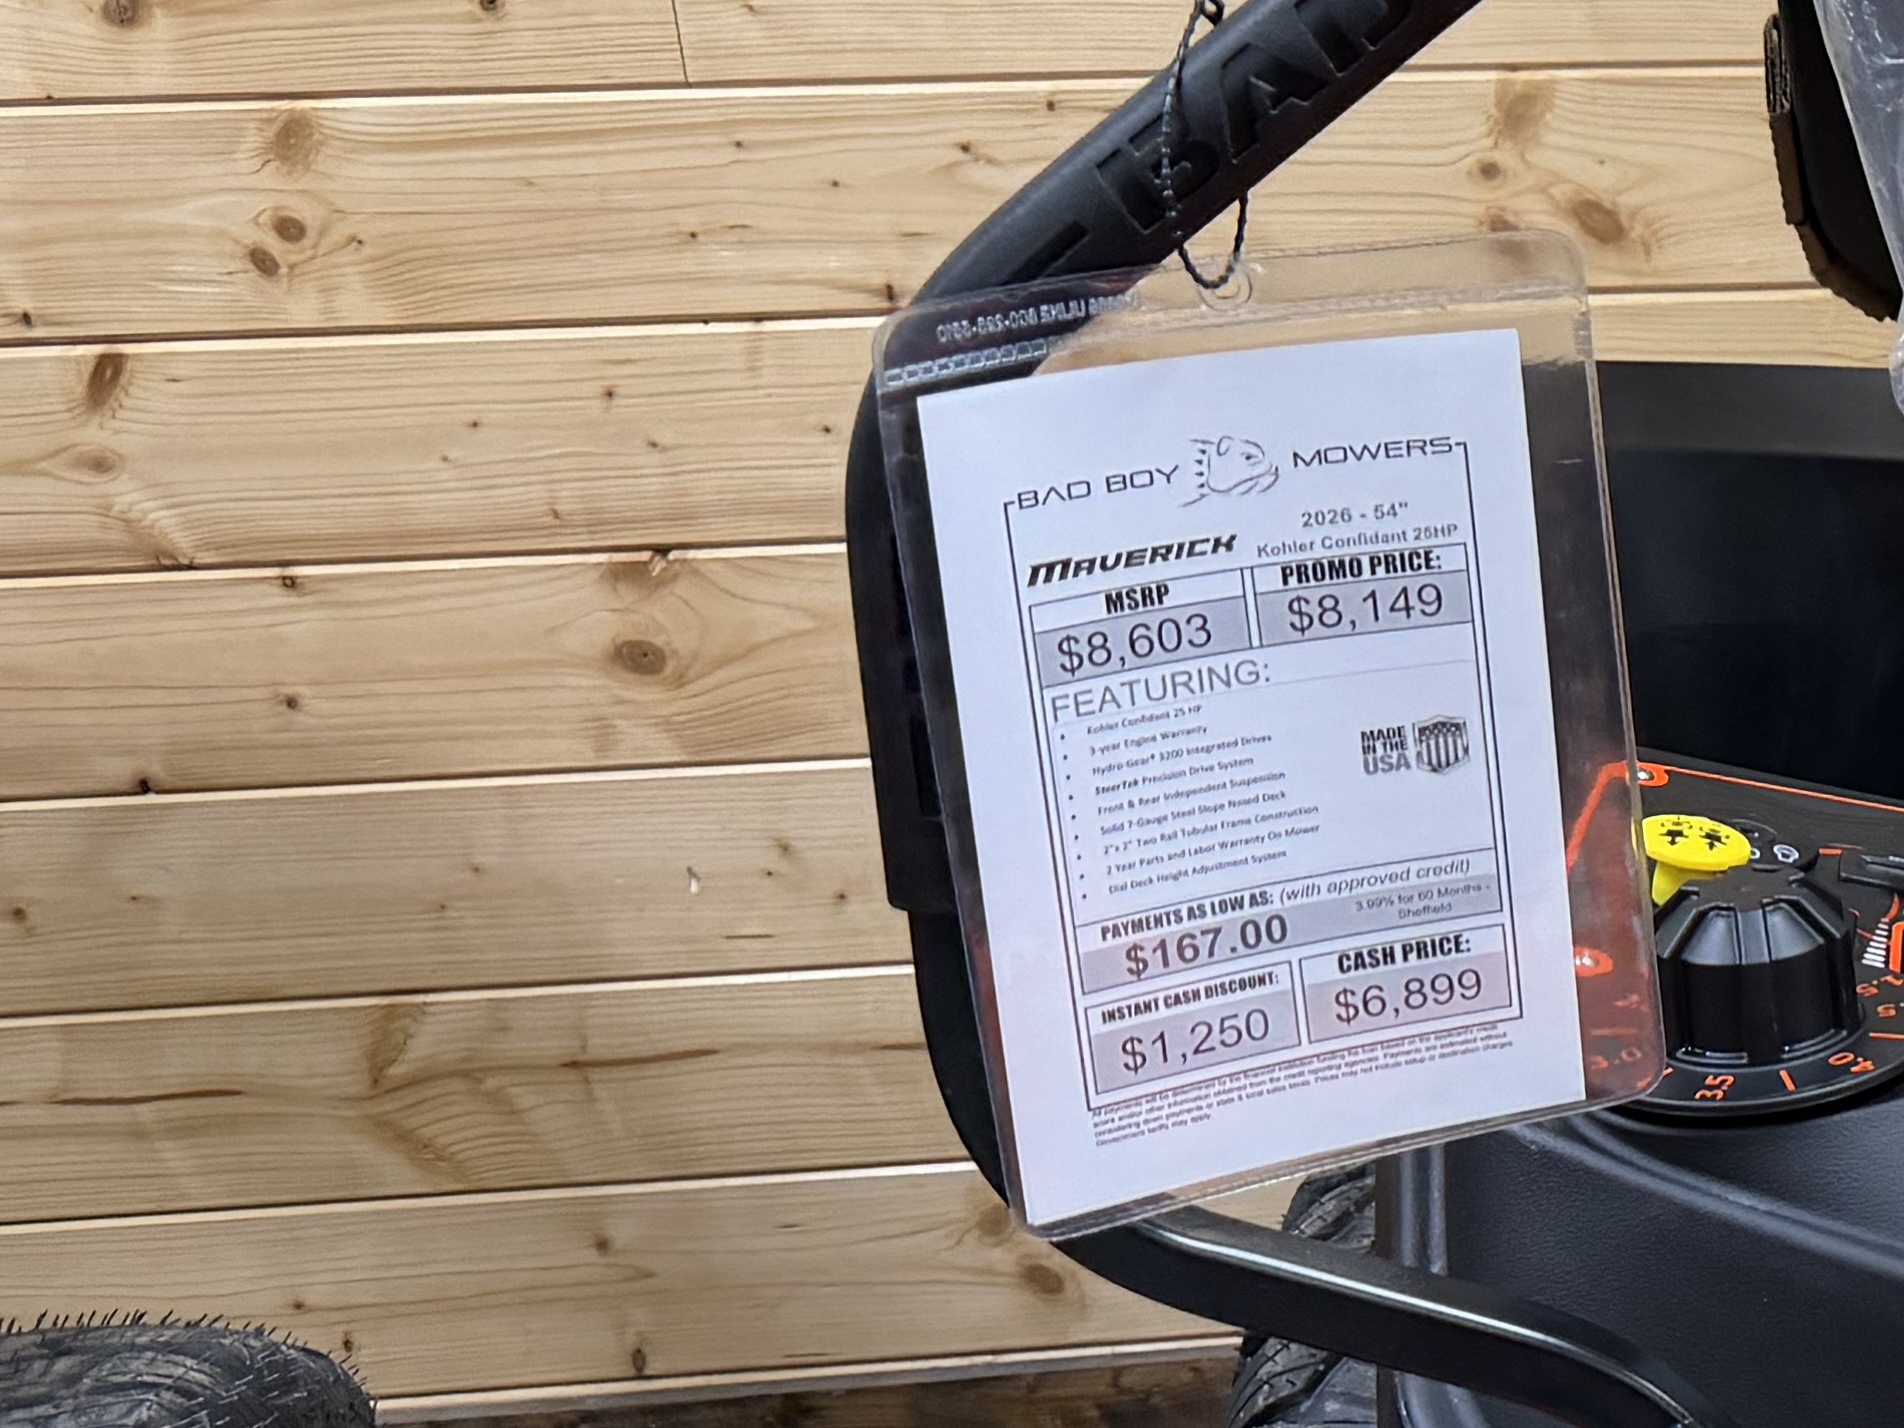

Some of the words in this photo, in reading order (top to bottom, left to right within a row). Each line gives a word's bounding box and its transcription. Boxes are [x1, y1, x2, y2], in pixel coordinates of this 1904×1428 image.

[1018, 481, 1091, 510] BAD
[1106, 464, 1179, 493] BOY
[1293, 437, 1452, 468] MOWERS
[1257, 541, 1314, 558] Kohler
[1321, 529, 1407, 549] Confidant
[1301, 507, 1352, 527] 2026
[1026, 533, 1237, 588] MAVERICK
[1281, 556, 1362, 586] PROMO
[1369, 550, 1441, 576] PRICE:
[1104, 583, 1170, 615] MSRP
[1288, 583, 1442, 636] $8,149
[1057, 613, 1212, 677] $8,603
[1051, 660, 1270, 723] FEATURING:
[1363, 752, 1411, 775] USA
[1101, 909, 1183, 941] PAYMENTS
[1187, 903, 1207, 921] AS
[1210, 895, 1245, 916] LOW
[1249, 890, 1274, 909] AS:
[1279, 882, 1321, 906] (with
[1327, 867, 1411, 894] approved
[1416, 858, 1470, 879] credit)
[1125, 914, 1288, 980] $167.00
[1337, 945, 1396, 973] CASH
[1401, 934, 1471, 962] PRICE:
[1102, 998, 1159, 1025] INSTANT
[1164, 988, 1201, 1009] CASH
[1204, 972, 1279, 1000] DISCOUNT:
[1334, 968, 1482, 1026] $6,899
[1121, 1008, 1270, 1075] $1,250
